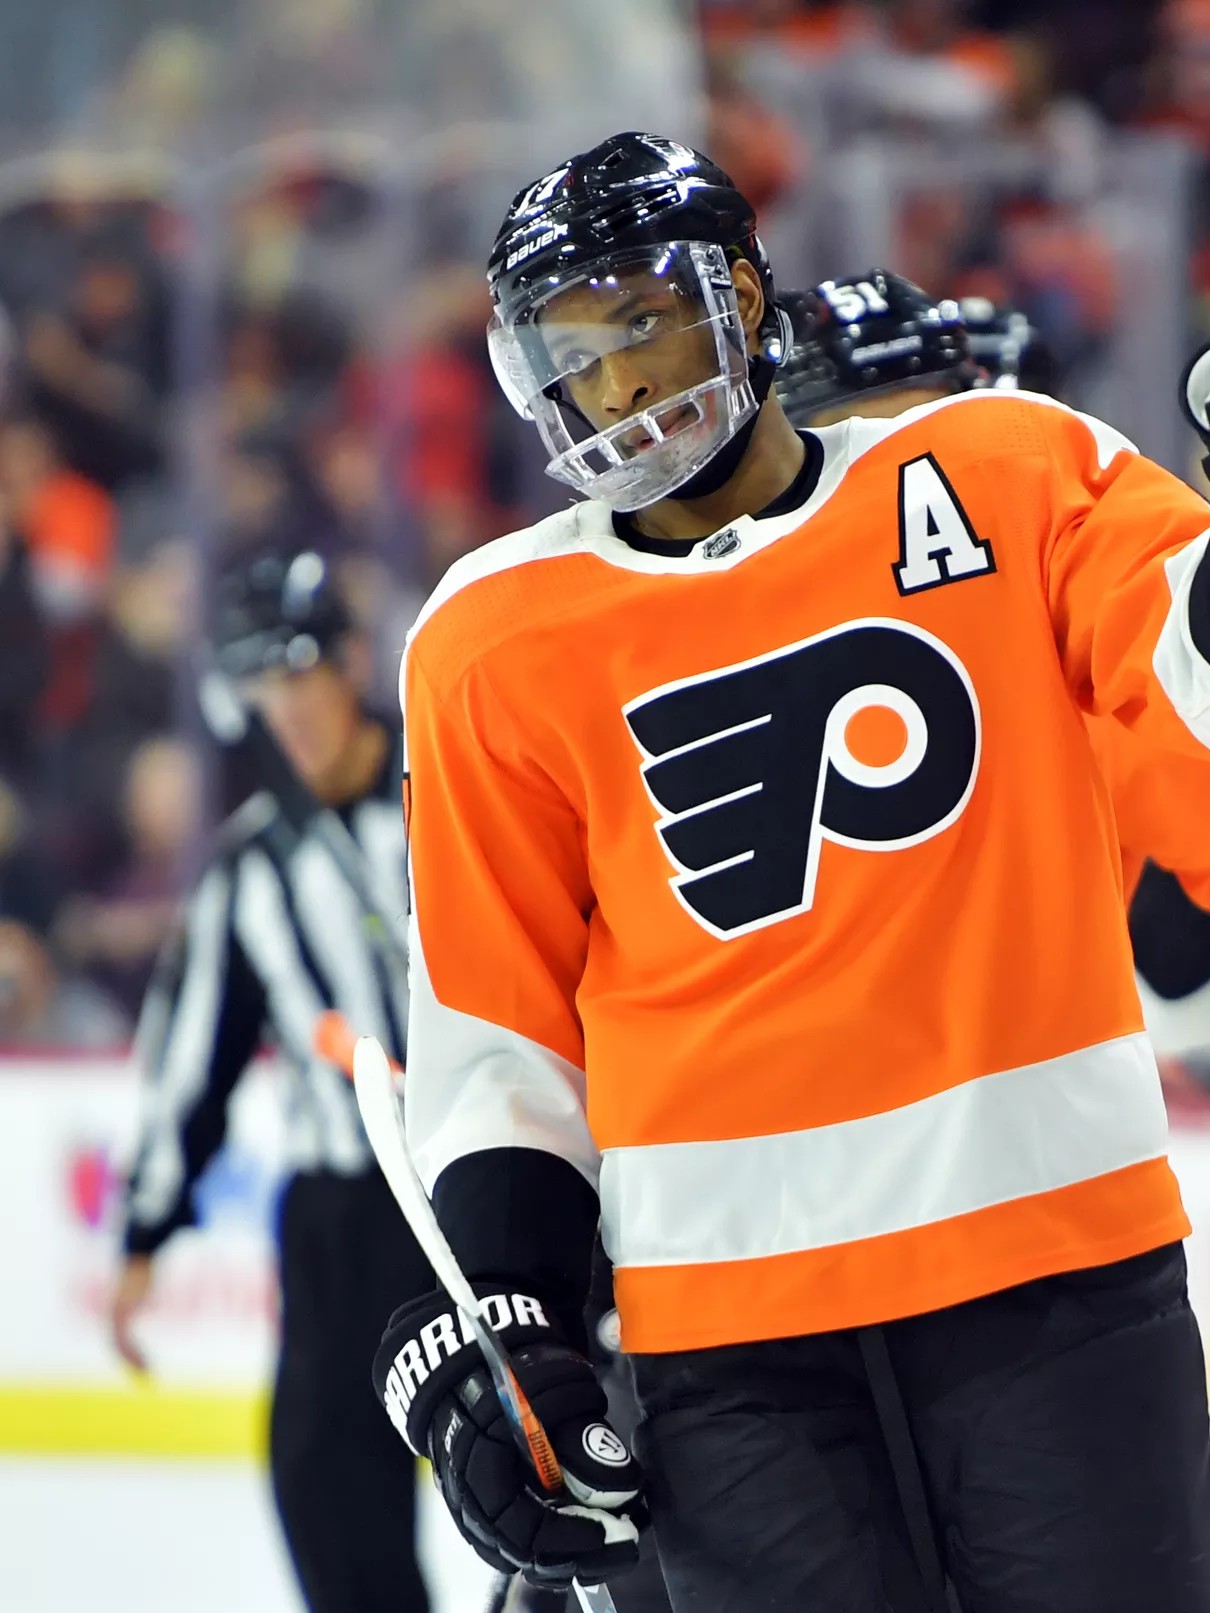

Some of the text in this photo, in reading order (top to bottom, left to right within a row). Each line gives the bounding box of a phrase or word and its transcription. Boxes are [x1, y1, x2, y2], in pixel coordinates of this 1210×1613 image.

[512, 167, 570, 220] 17
[827, 280, 891, 322] 51
[892, 452, 996, 596] A
